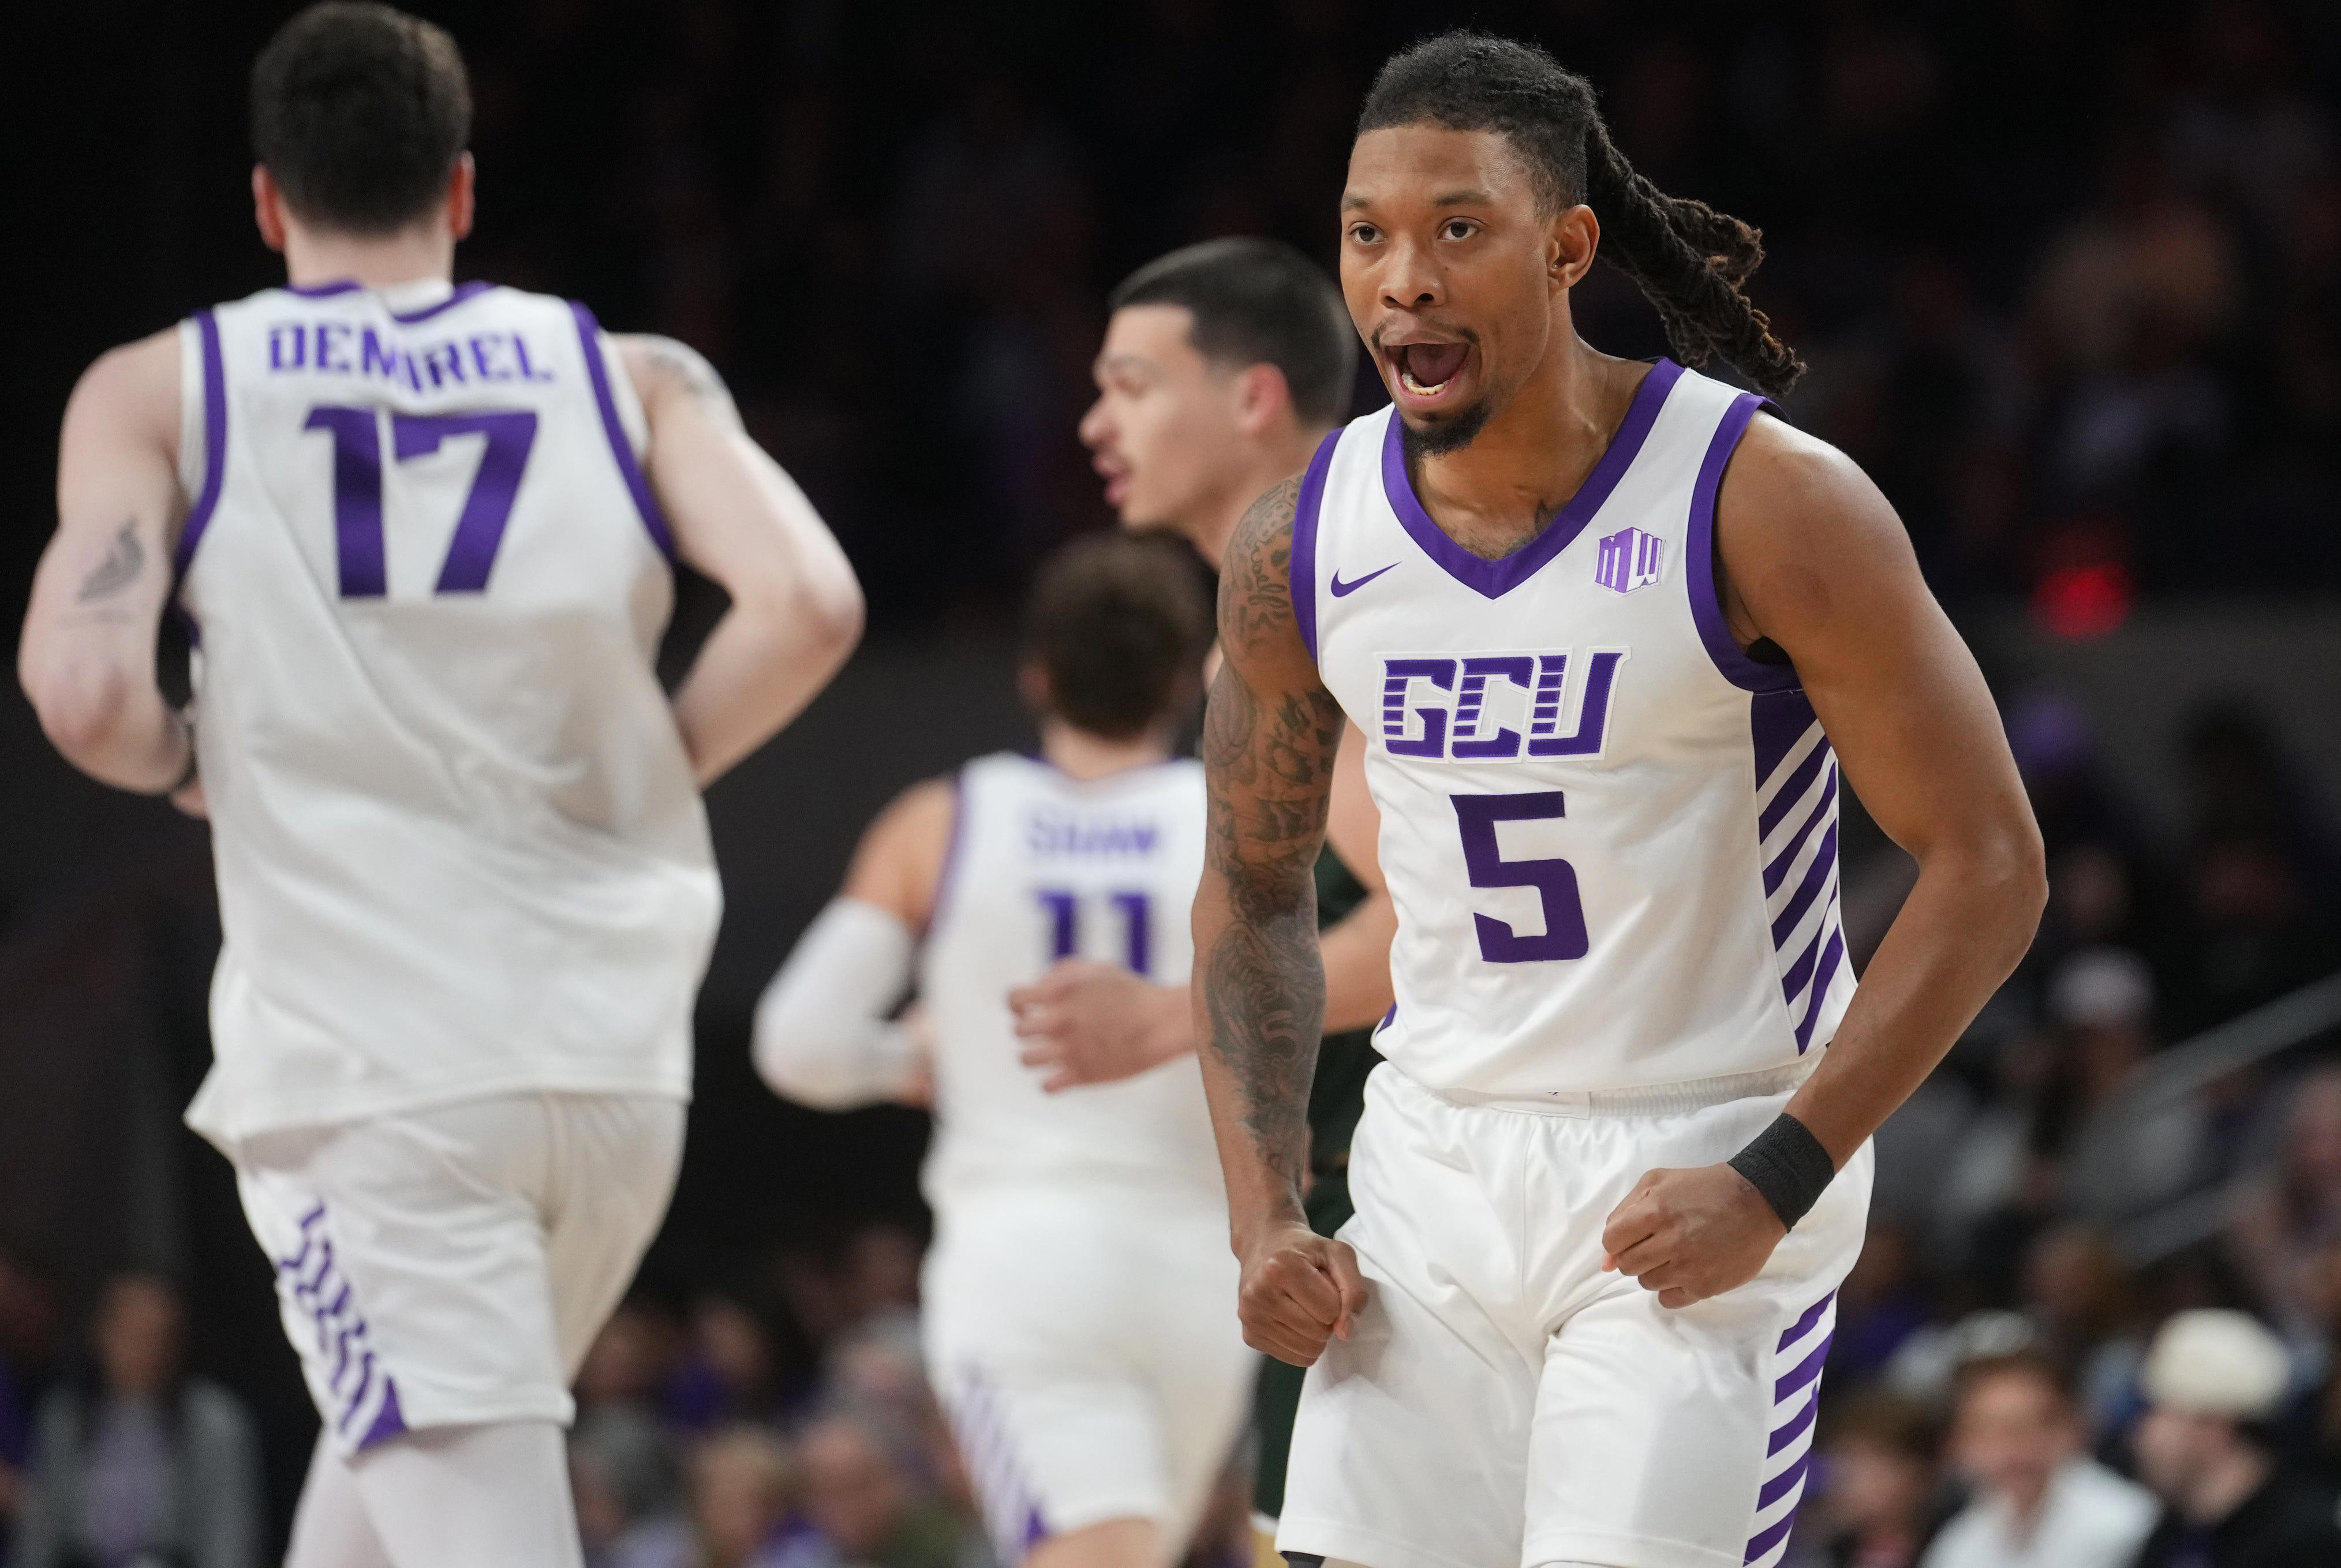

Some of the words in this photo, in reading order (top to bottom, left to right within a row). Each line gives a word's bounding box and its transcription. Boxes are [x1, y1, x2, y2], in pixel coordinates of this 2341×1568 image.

[269, 323, 555, 394] DEMIREL
[302, 406, 539, 599] 17
[1383, 652, 1624, 758] GCU
[1449, 791, 1590, 963] 5
[1035, 890, 1150, 976] 11
